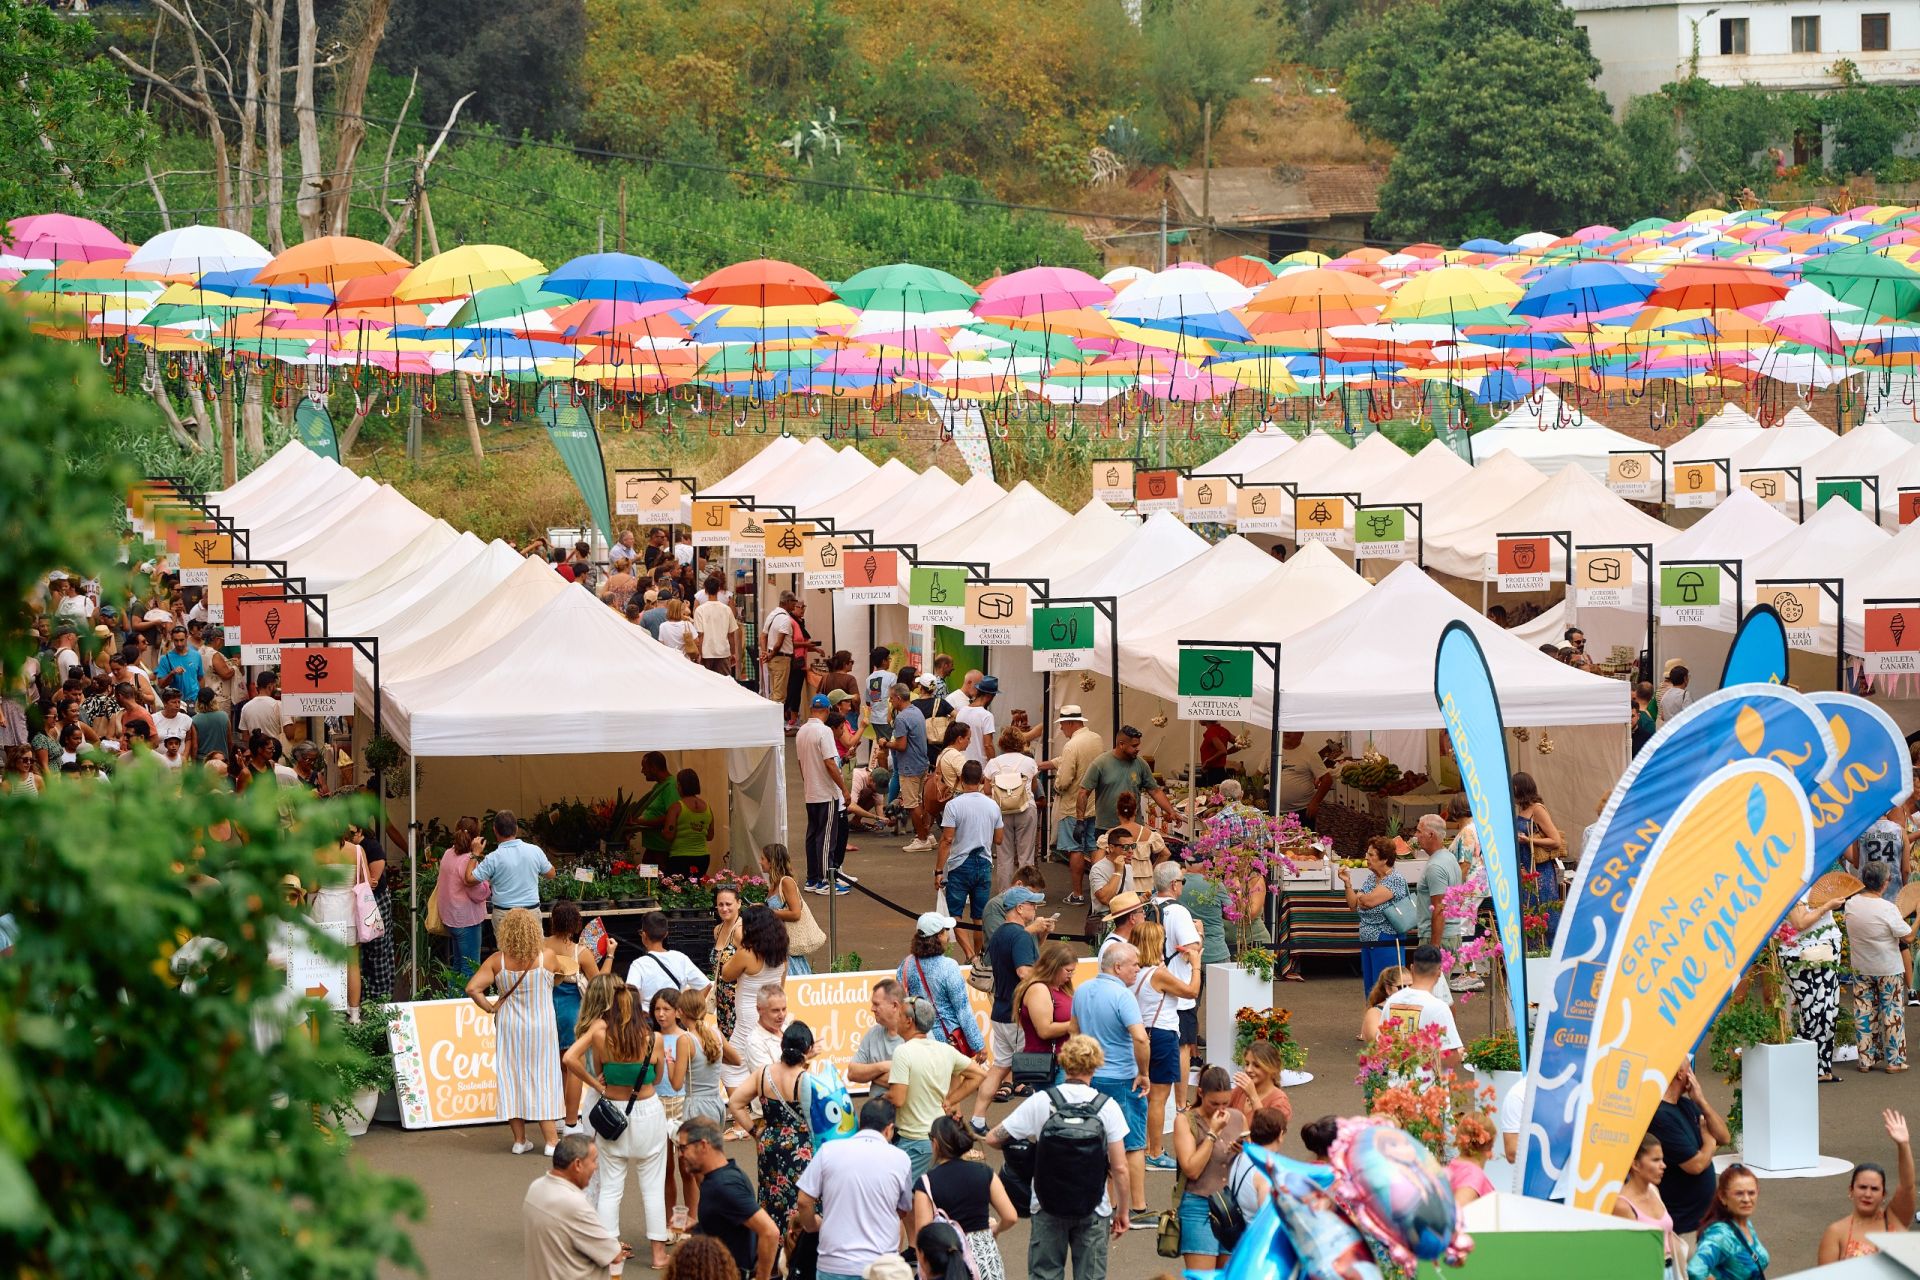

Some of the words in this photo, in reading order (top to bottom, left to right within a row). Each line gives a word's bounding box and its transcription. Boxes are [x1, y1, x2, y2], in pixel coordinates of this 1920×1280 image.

[851, 592, 891, 600] FRUTIZUM
[229, 632, 240, 640] EL
[1788, 631, 1811, 639] LERÍA
[299, 697, 337, 705] VIVEROS
[302, 704, 335, 712] FATAGA
[1191, 701, 1239, 709] ACEITUNAS
[1188, 708, 1215, 716] SANTA
[1589, 818, 1663, 897] GRAN
[1867, 841, 1895, 862] 24
[1620, 896, 1679, 977] GRAN
[1635, 872, 1731, 995] CANARIA
[1657, 955, 1708, 1028] me
[1702, 831, 1797, 970] gusta
[797, 979, 872, 1007] Calidad
[455, 1004, 497, 1038] Pa
[436, 1085, 497, 1118] Econ
